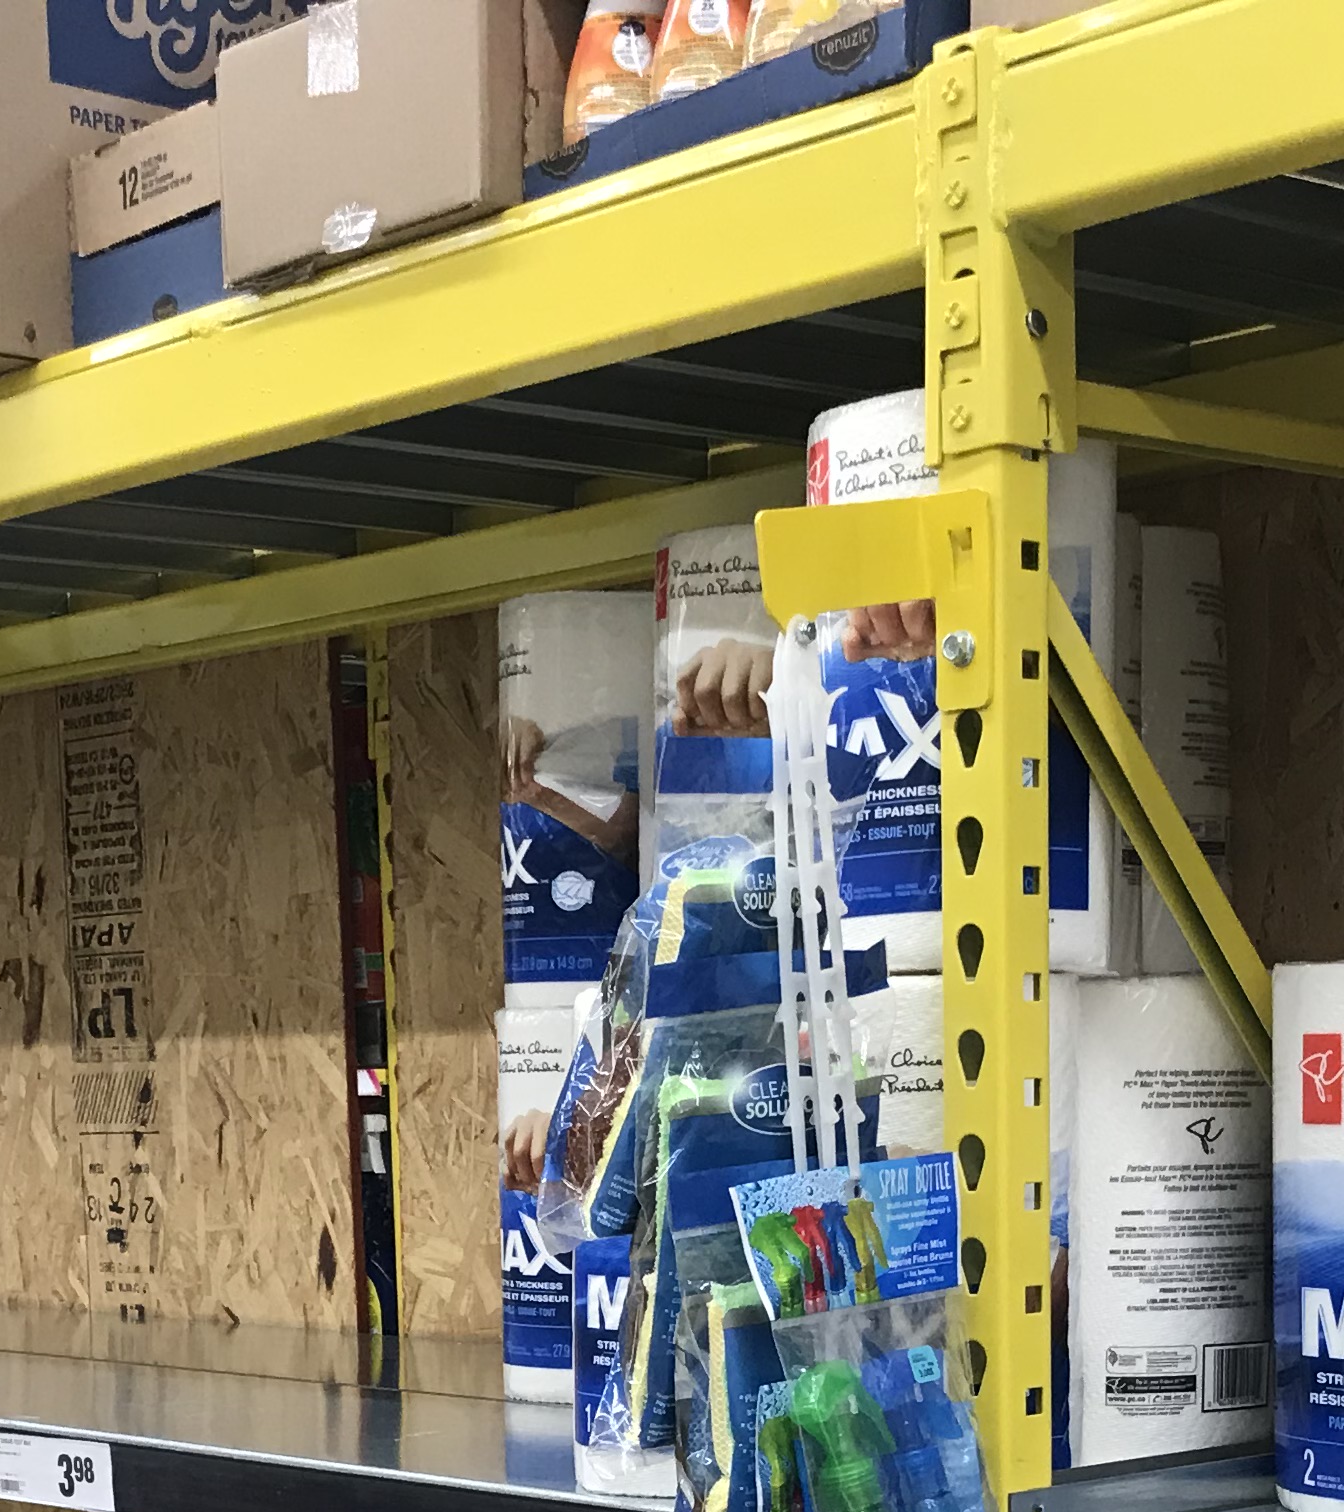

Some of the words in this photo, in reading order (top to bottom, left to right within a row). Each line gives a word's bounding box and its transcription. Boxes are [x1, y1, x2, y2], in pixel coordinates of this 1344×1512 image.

[820, 22, 869, 55] renuzit
[70, 105, 125, 134] PAPER
[119, 166, 139, 210] 12
[869, 823, 935, 840] ESSUIE-TOUT
[879, 1168, 908, 1199] SPRAY
[916, 1161, 951, 1194] BOTTLE
[516, 1280, 562, 1290] THICKNESS
[520, 1292, 569, 1303] ÉPAISSEUR
[1304, 1448, 1315, 1486] 2
